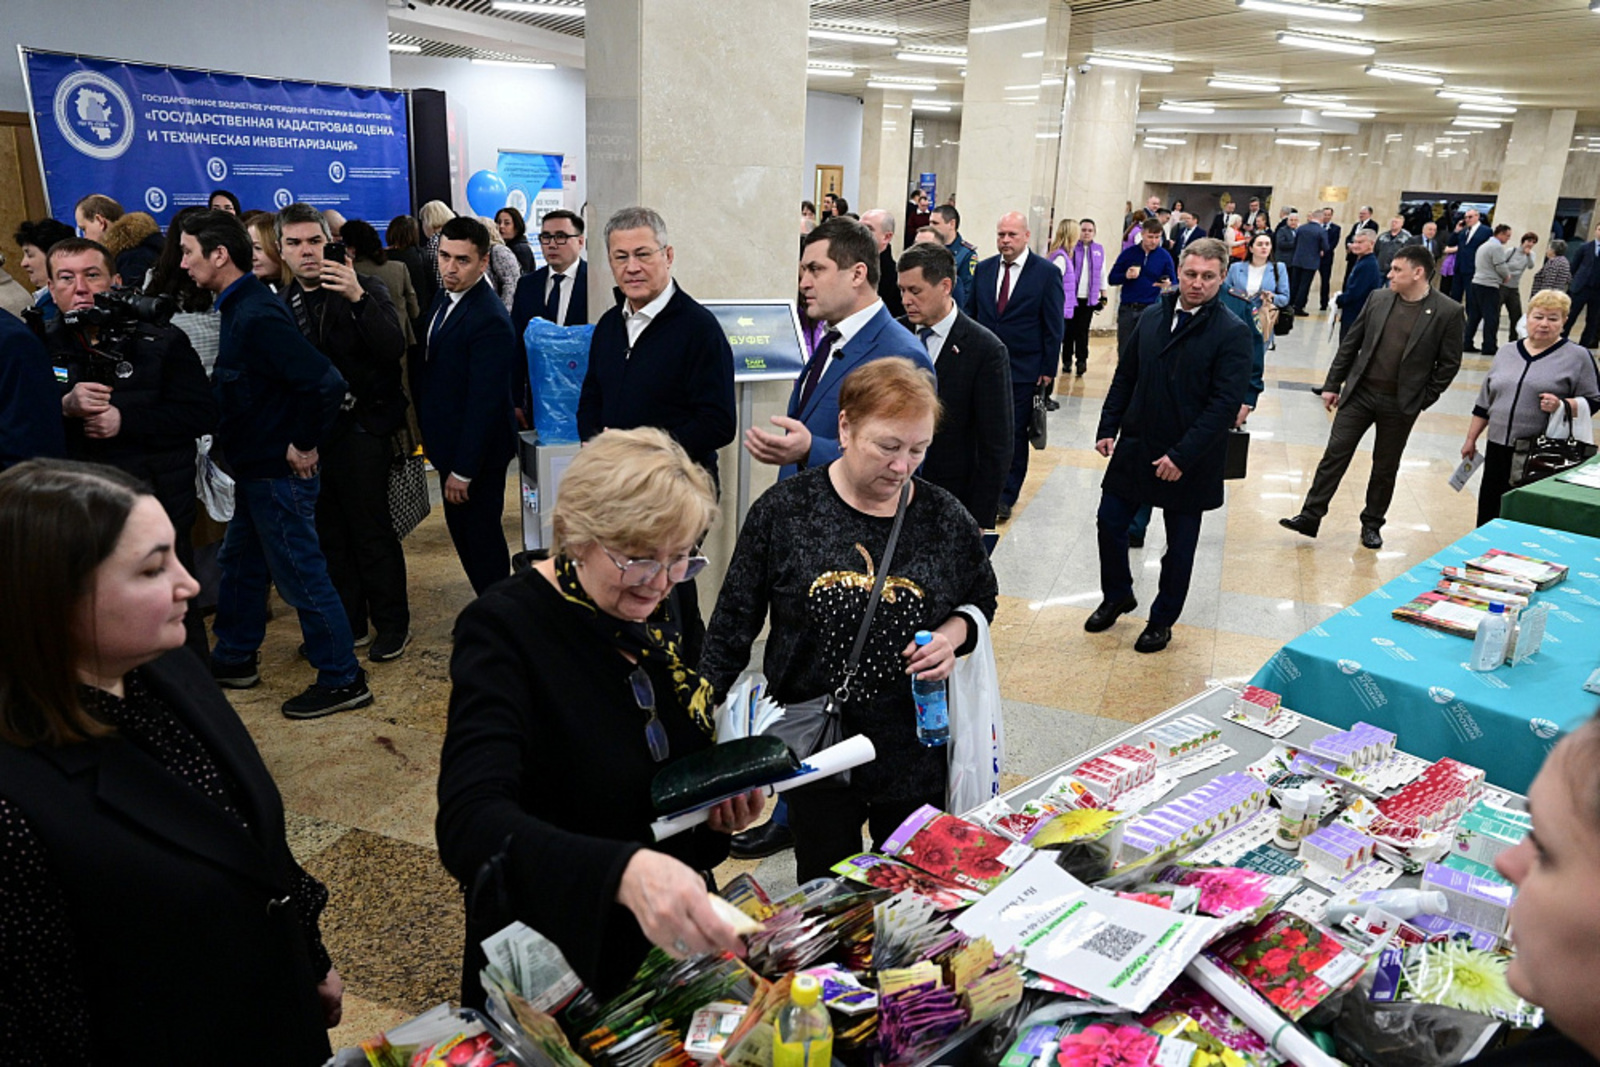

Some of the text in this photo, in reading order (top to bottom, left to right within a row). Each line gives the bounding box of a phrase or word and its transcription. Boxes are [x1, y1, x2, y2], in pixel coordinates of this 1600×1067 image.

[144, 109, 395, 136] «ГОСУДАРСТВЕННАЯ КАДАСТРОВАЯ ОЦЕНКА
[147, 129, 358, 152] И ТЕХНИЧЕСКАЯ ИНВЕНТАРИЗАЦИЯ»
[728, 334, 771, 345] БУФЕТ
[1023, 886, 1038, 899] На
